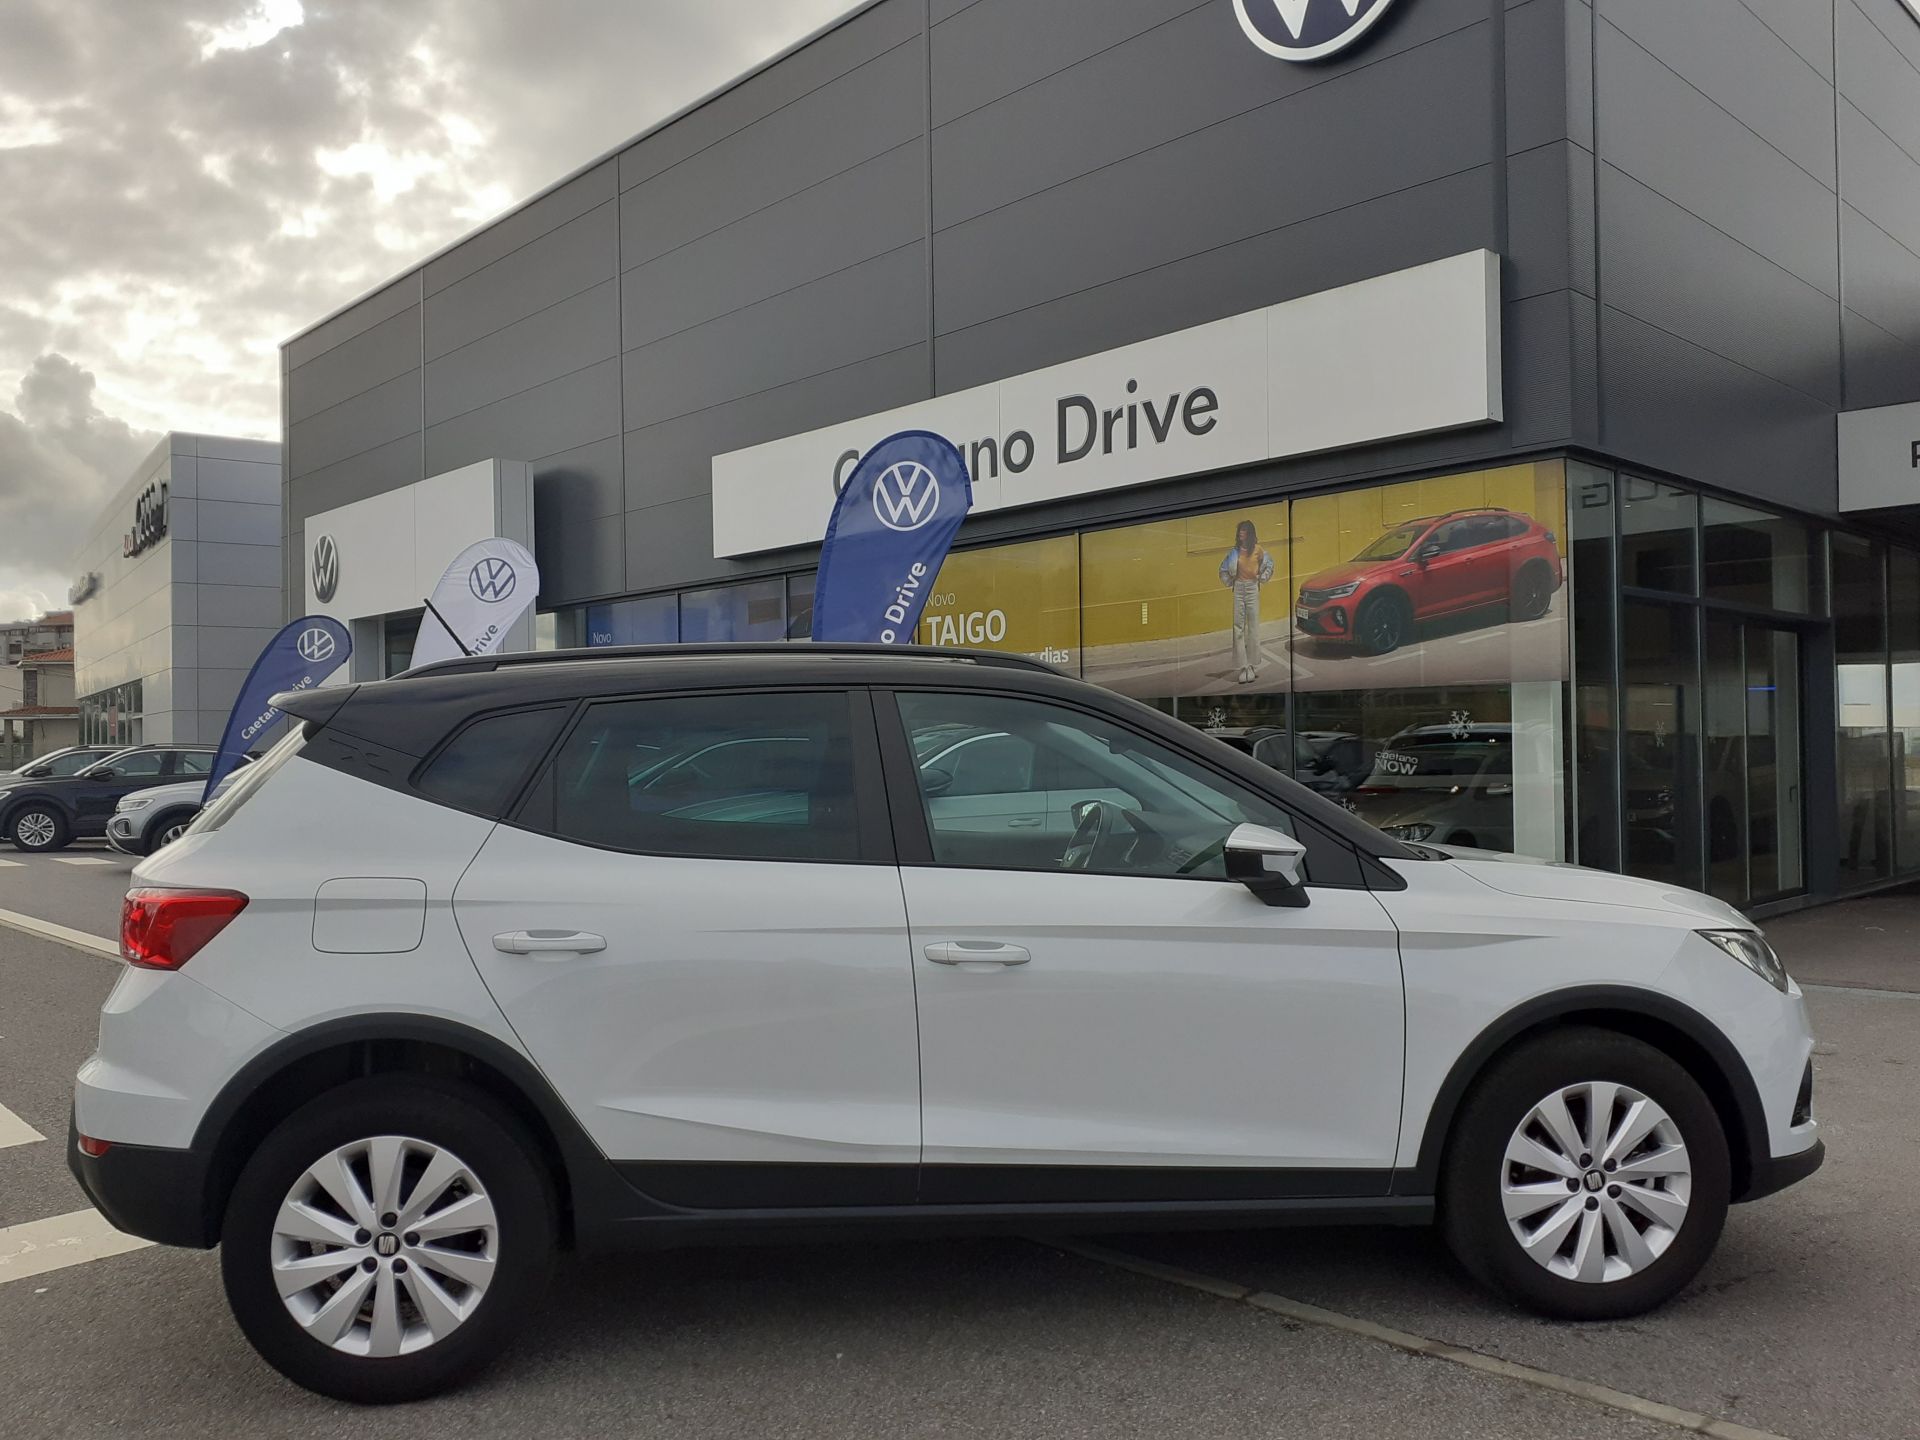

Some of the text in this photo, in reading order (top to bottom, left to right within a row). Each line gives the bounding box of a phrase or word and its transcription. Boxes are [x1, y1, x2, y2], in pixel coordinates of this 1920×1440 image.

[1057, 378, 1219, 465] Drive
[885, 562, 927, 624] Drive
[925, 592, 956, 608] Novo
[926, 609, 1006, 646] TAIGO
[593, 632, 612, 644] Novo
[1039, 646, 1070, 664] dias
[241, 706, 279, 740] Caetan
[1376, 751, 1418, 764] caetano
[1374, 759, 1418, 775] NOW
